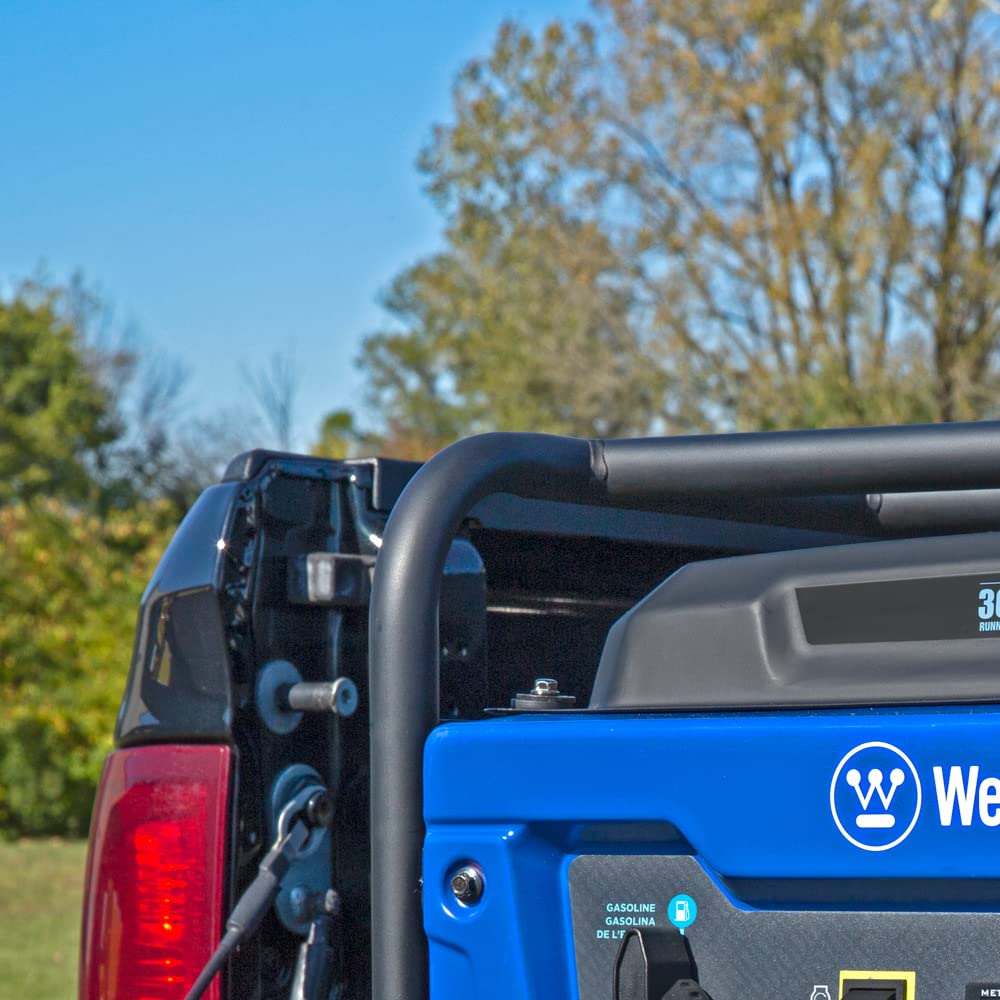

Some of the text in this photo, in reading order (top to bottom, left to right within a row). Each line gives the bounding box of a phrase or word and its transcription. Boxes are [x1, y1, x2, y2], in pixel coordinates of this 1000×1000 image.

[606, 903, 656, 913] GASOLINE
[605, 916, 656, 926] GASOLINA
[596, 930, 610, 939] DE
